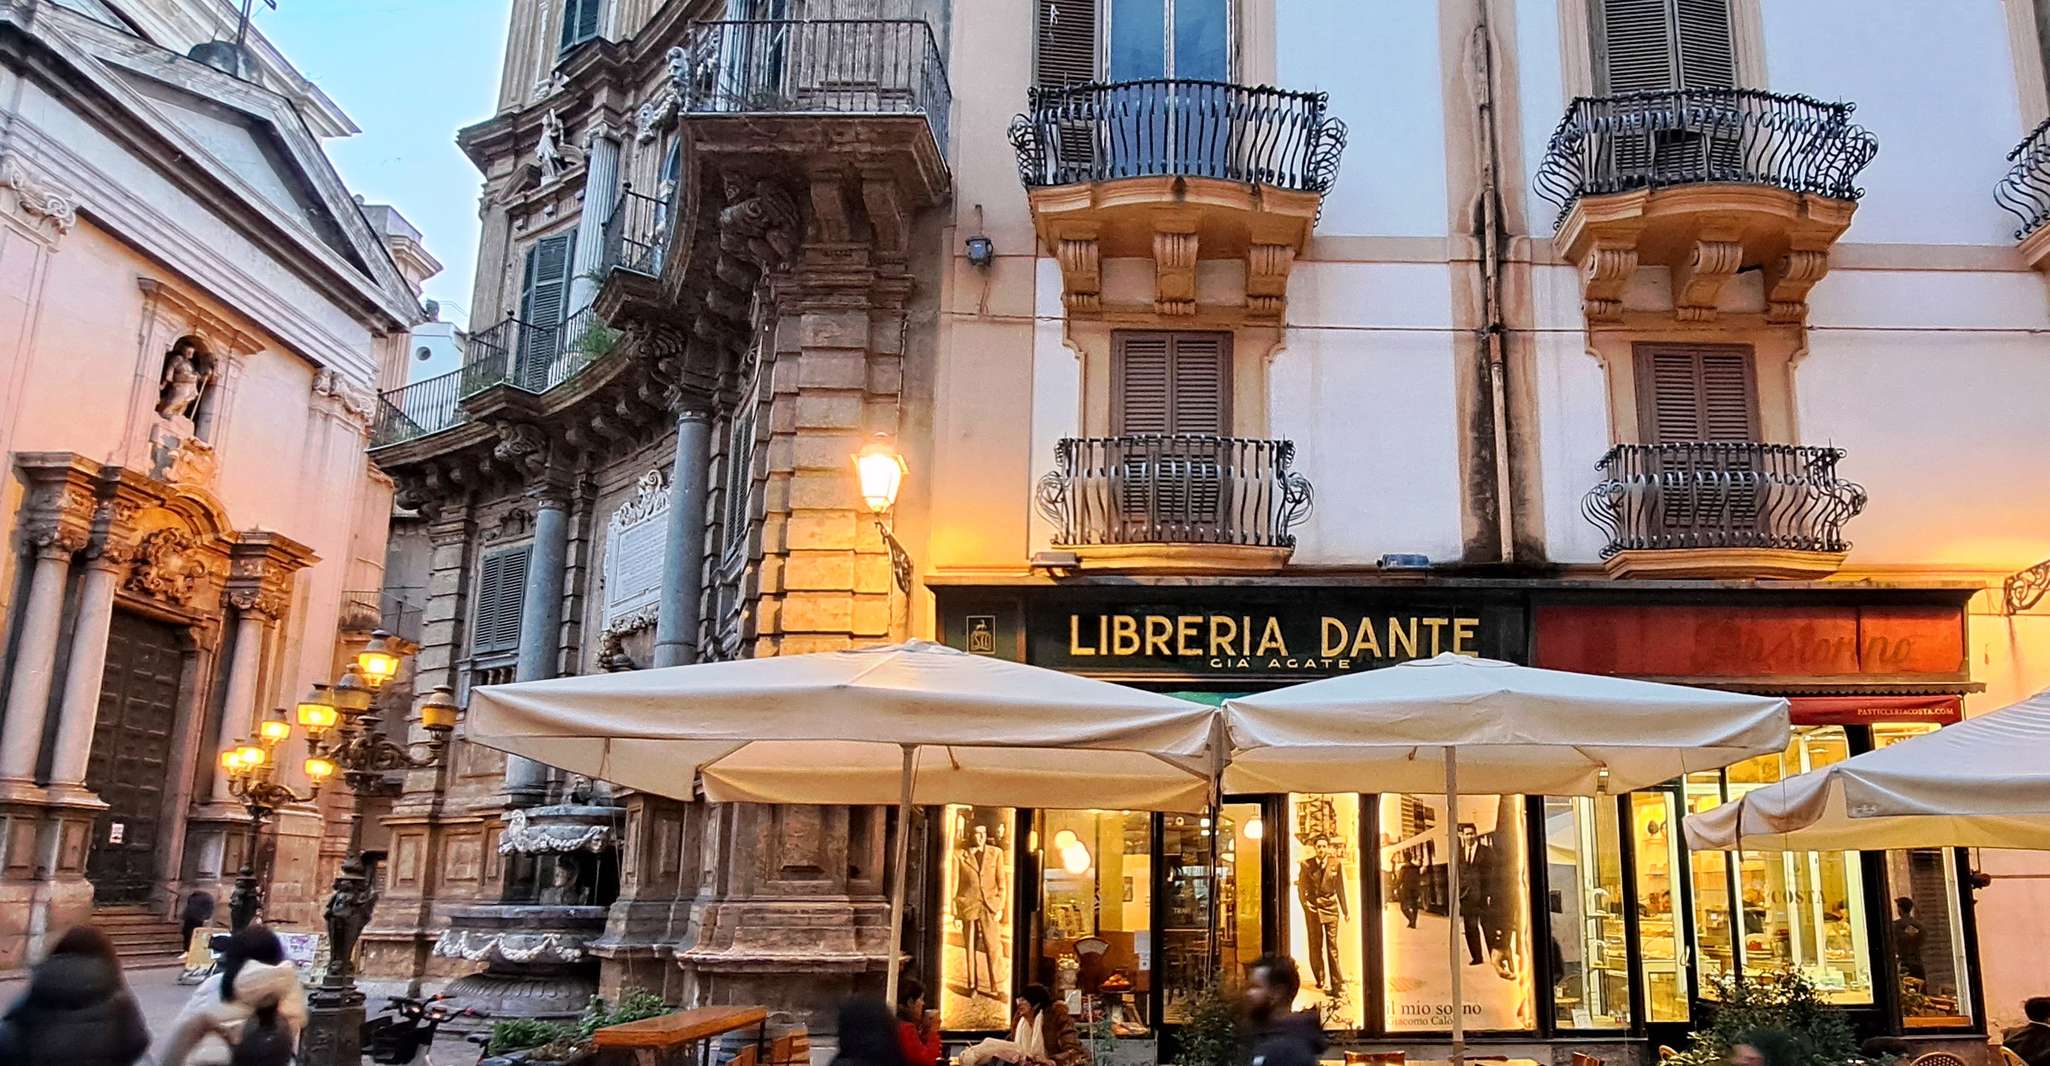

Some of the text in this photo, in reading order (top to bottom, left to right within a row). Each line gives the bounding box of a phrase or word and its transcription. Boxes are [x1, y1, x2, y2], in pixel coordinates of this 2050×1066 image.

[1070, 614, 1479, 658] LIBRERIA DANTE
[1267, 658, 1350, 669] AGATE
[1857, 708, 1954, 716] PASTICCERIACOSTA.COM
[1401, 1000, 1431, 1015] mio
[1436, 1003, 1482, 1015] sono
